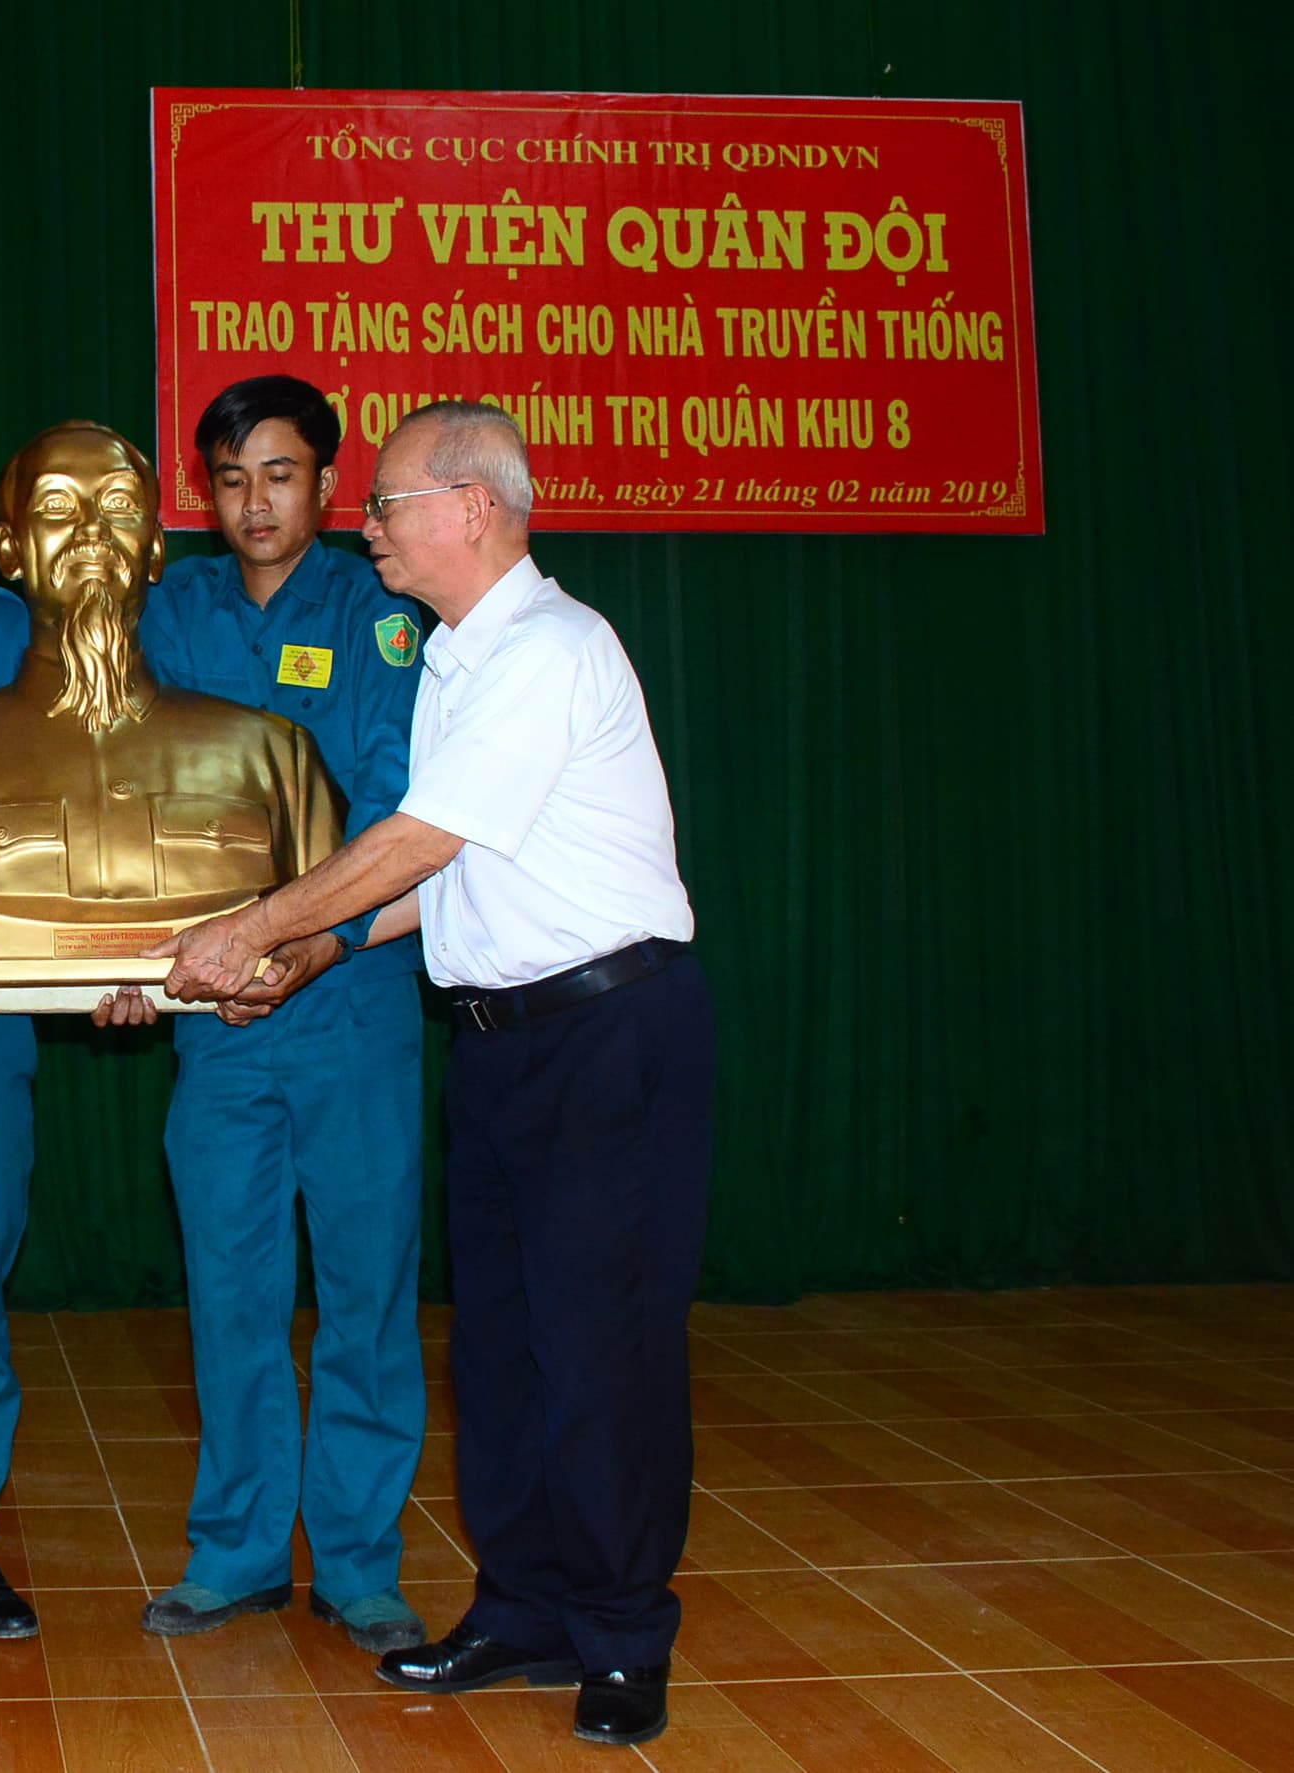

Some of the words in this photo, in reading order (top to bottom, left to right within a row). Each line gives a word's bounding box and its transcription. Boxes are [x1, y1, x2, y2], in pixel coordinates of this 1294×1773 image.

[306, 124, 413, 161] TỔNG
[424, 137, 505, 167] CỤC
[516, 133, 638, 165] CHÍNH
[648, 140, 712, 172] TRỊ
[722, 142, 880, 172] QĐNDVN
[252, 197, 404, 264] THƯ
[417, 188, 587, 280] VIỆN
[607, 192, 807, 273] QUÂN
[824, 195, 949, 287] ĐỘI
[191, 300, 294, 352] TRAO
[306, 292, 410, 366] TẶNG
[422, 289, 523, 354] SÁCH
[537, 303, 614, 356] CHO
[627, 293, 704, 357] NHÀ
[716, 287, 867, 359] TRUYỀN
[877, 291, 1004, 361] THỐNG
[479, 381, 593, 446] HÍNH
[605, 396, 669, 459] TRỊ
[682, 383, 784, 456] QUÂN
[797, 399, 874, 449] KHU
[887, 399, 911, 449] 8
[530, 477, 606, 505] Ninh,
[615, 480, 686, 506] ngày
[692, 478, 724, 503] 21
[735, 478, 818, 507] tháng
[826, 479, 860, 503] 02
[870, 480, 931, 503] năm
[941, 480, 1007, 504] 2019
